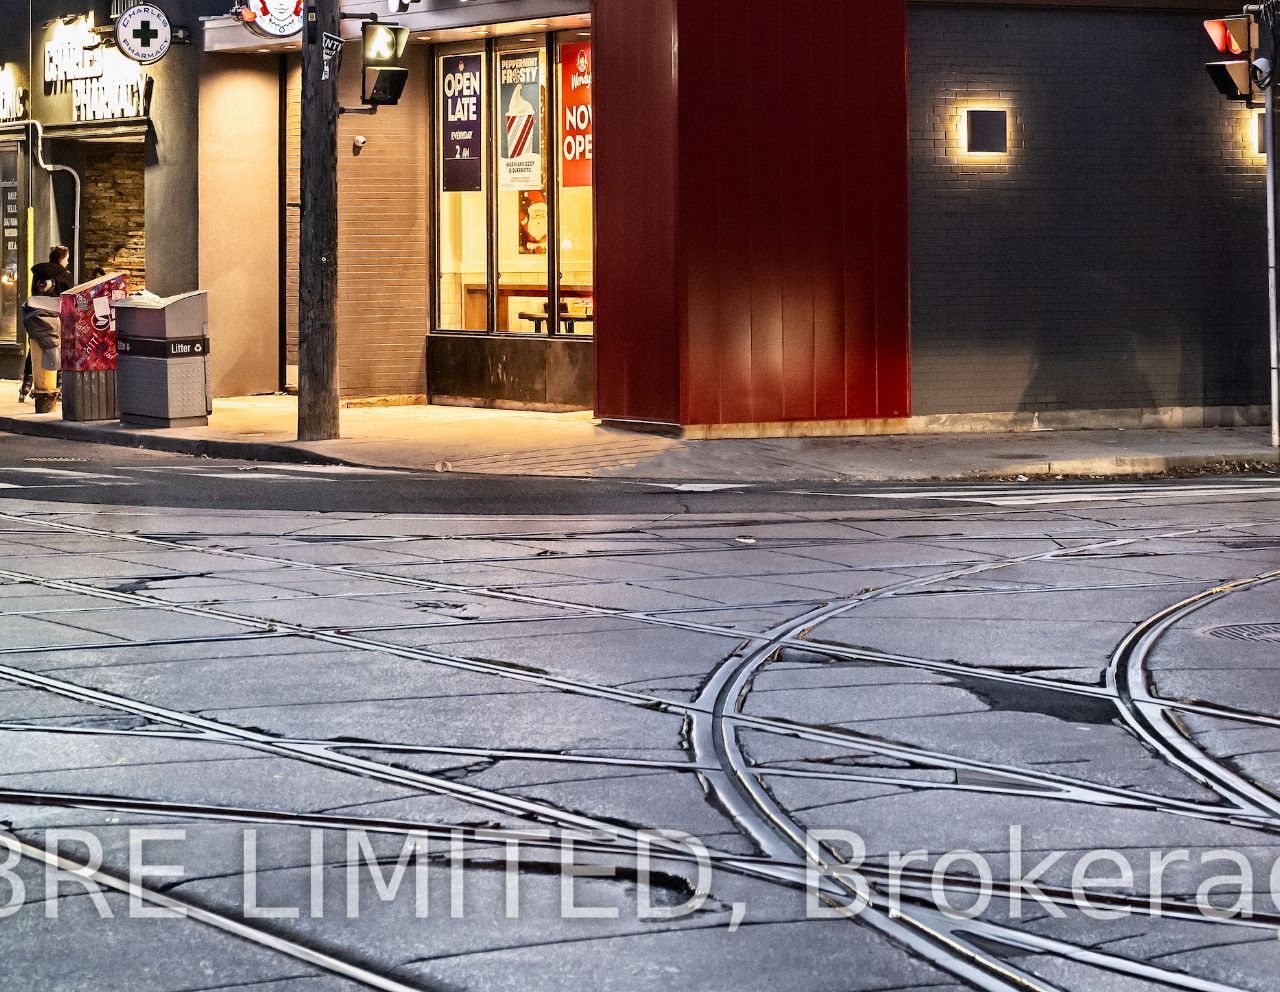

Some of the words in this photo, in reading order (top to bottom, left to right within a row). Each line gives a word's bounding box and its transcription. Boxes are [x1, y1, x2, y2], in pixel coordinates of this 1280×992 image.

[122, 7, 169, 28] CHARLES
[122, 37, 169, 59] PHARMACY
[501, 57, 538, 69] PEPPERMINT
[445, 71, 480, 97] OPEN
[501, 67, 538, 84] FROSTY
[448, 97, 477, 121] LATE
[455, 145, 461, 158] 2
[563, 134, 592, 160] OPE
[171, 343, 191, 354] Litter
